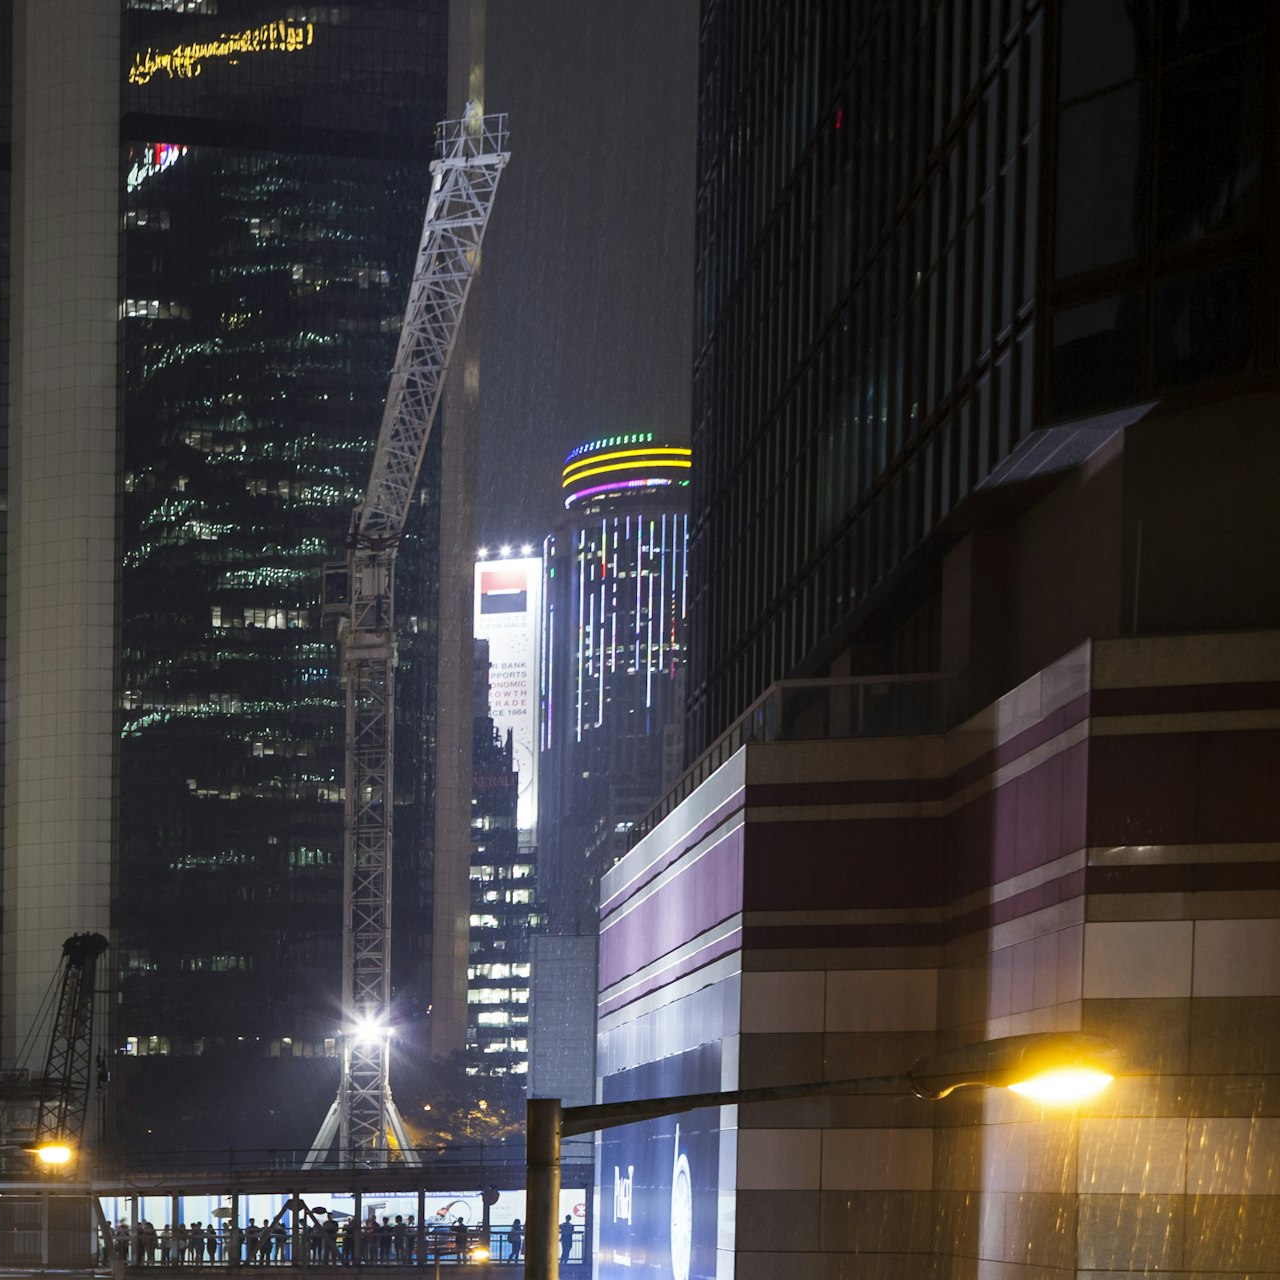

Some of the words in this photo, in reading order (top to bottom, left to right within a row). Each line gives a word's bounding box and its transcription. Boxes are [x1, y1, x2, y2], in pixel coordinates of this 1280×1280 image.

[501, 662, 527, 670] BANK
[490, 671, 527, 679] PPORTS
[490, 681, 527, 689] ONOMIC
[508, 708, 527, 716] 1864
